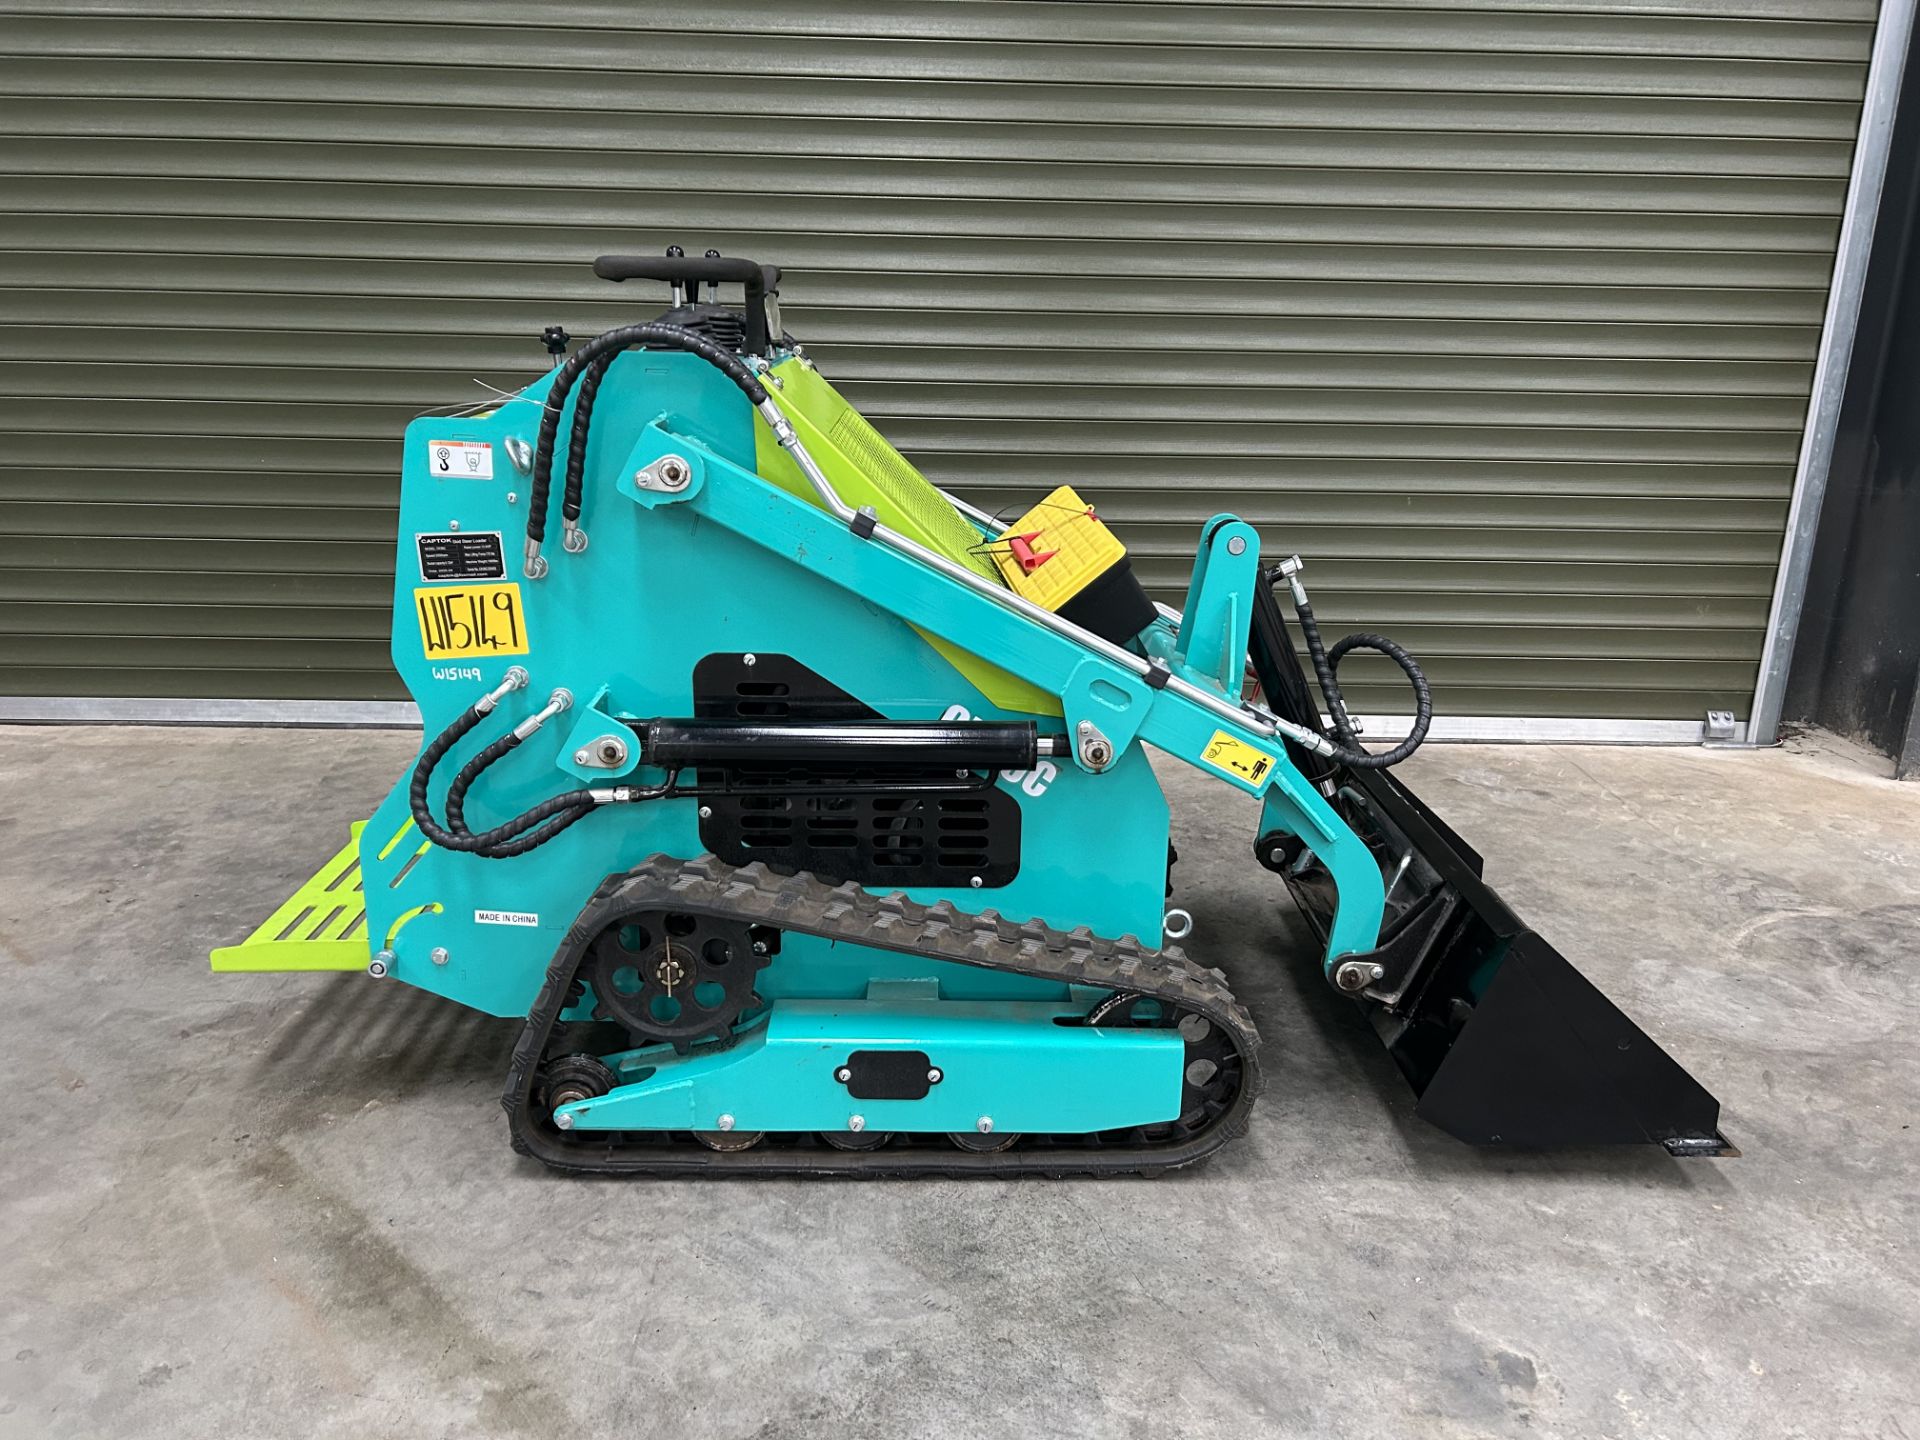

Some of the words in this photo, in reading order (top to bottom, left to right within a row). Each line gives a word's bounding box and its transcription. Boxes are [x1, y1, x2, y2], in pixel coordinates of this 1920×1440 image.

[419, 591, 518, 651] W15149
[432, 667, 482, 681] W15149
[478, 913, 501, 922] MADE
[502, 914, 511, 922] IN
[512, 915, 537, 924] CHINA
